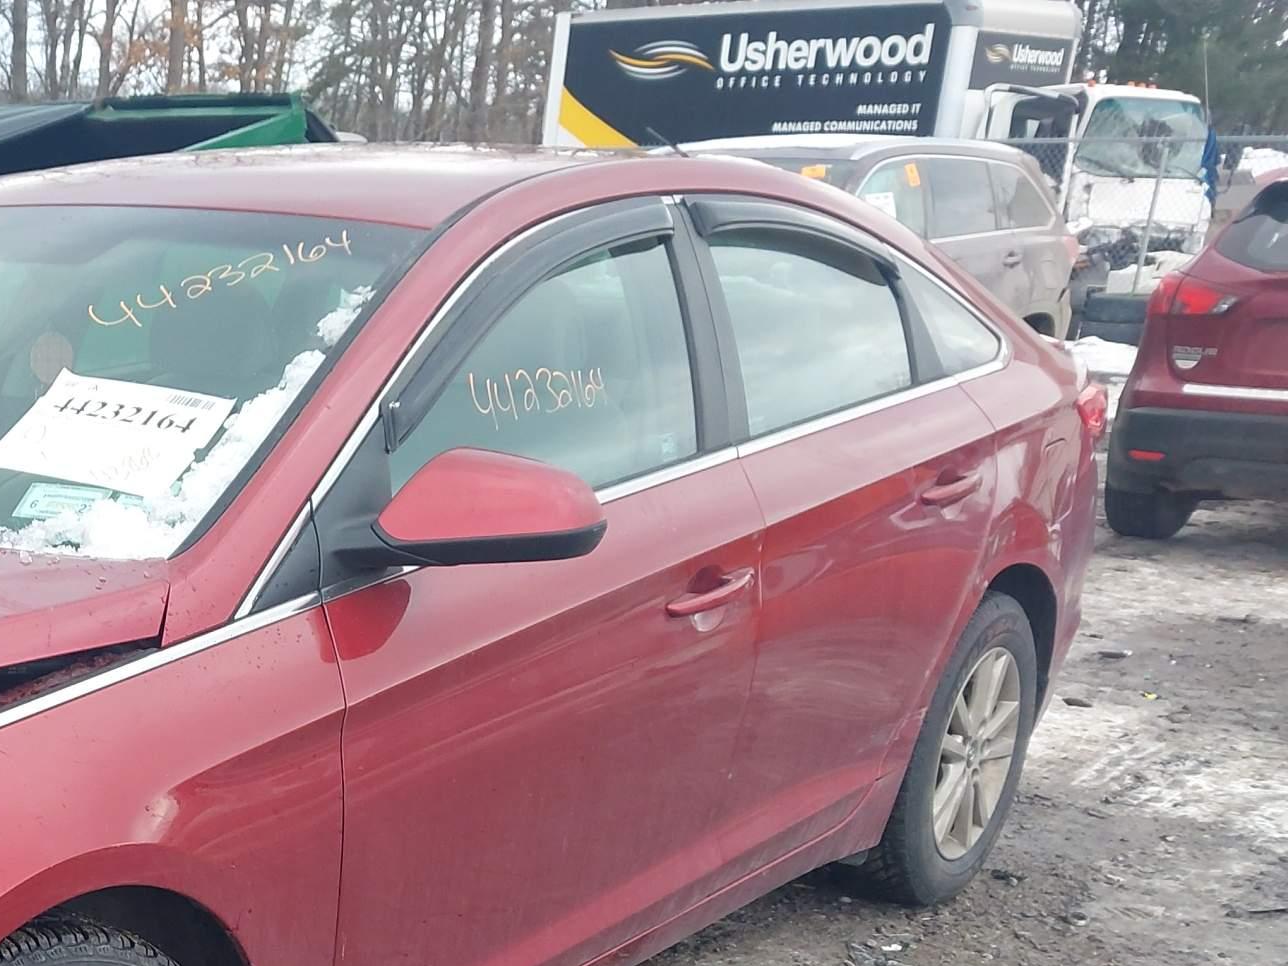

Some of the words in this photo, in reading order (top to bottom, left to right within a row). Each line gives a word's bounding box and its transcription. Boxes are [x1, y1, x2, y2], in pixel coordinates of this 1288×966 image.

[719, 23, 935, 73] Usherwood
[1011, 43, 1065, 66] Usherwood
[716, 75, 782, 89] OFFICE
[797, 70, 928, 88] TECHNOLOGY
[856, 103, 910, 116] MANAGED
[910, 103, 922, 115] IT
[772, 121, 822, 133] MANAGED
[823, 119, 919, 132] COMMUNICATIONS
[87, 230, 352, 328] 44232164
[468, 367, 610, 432] 44232164
[52, 397, 198, 434] 44232164
